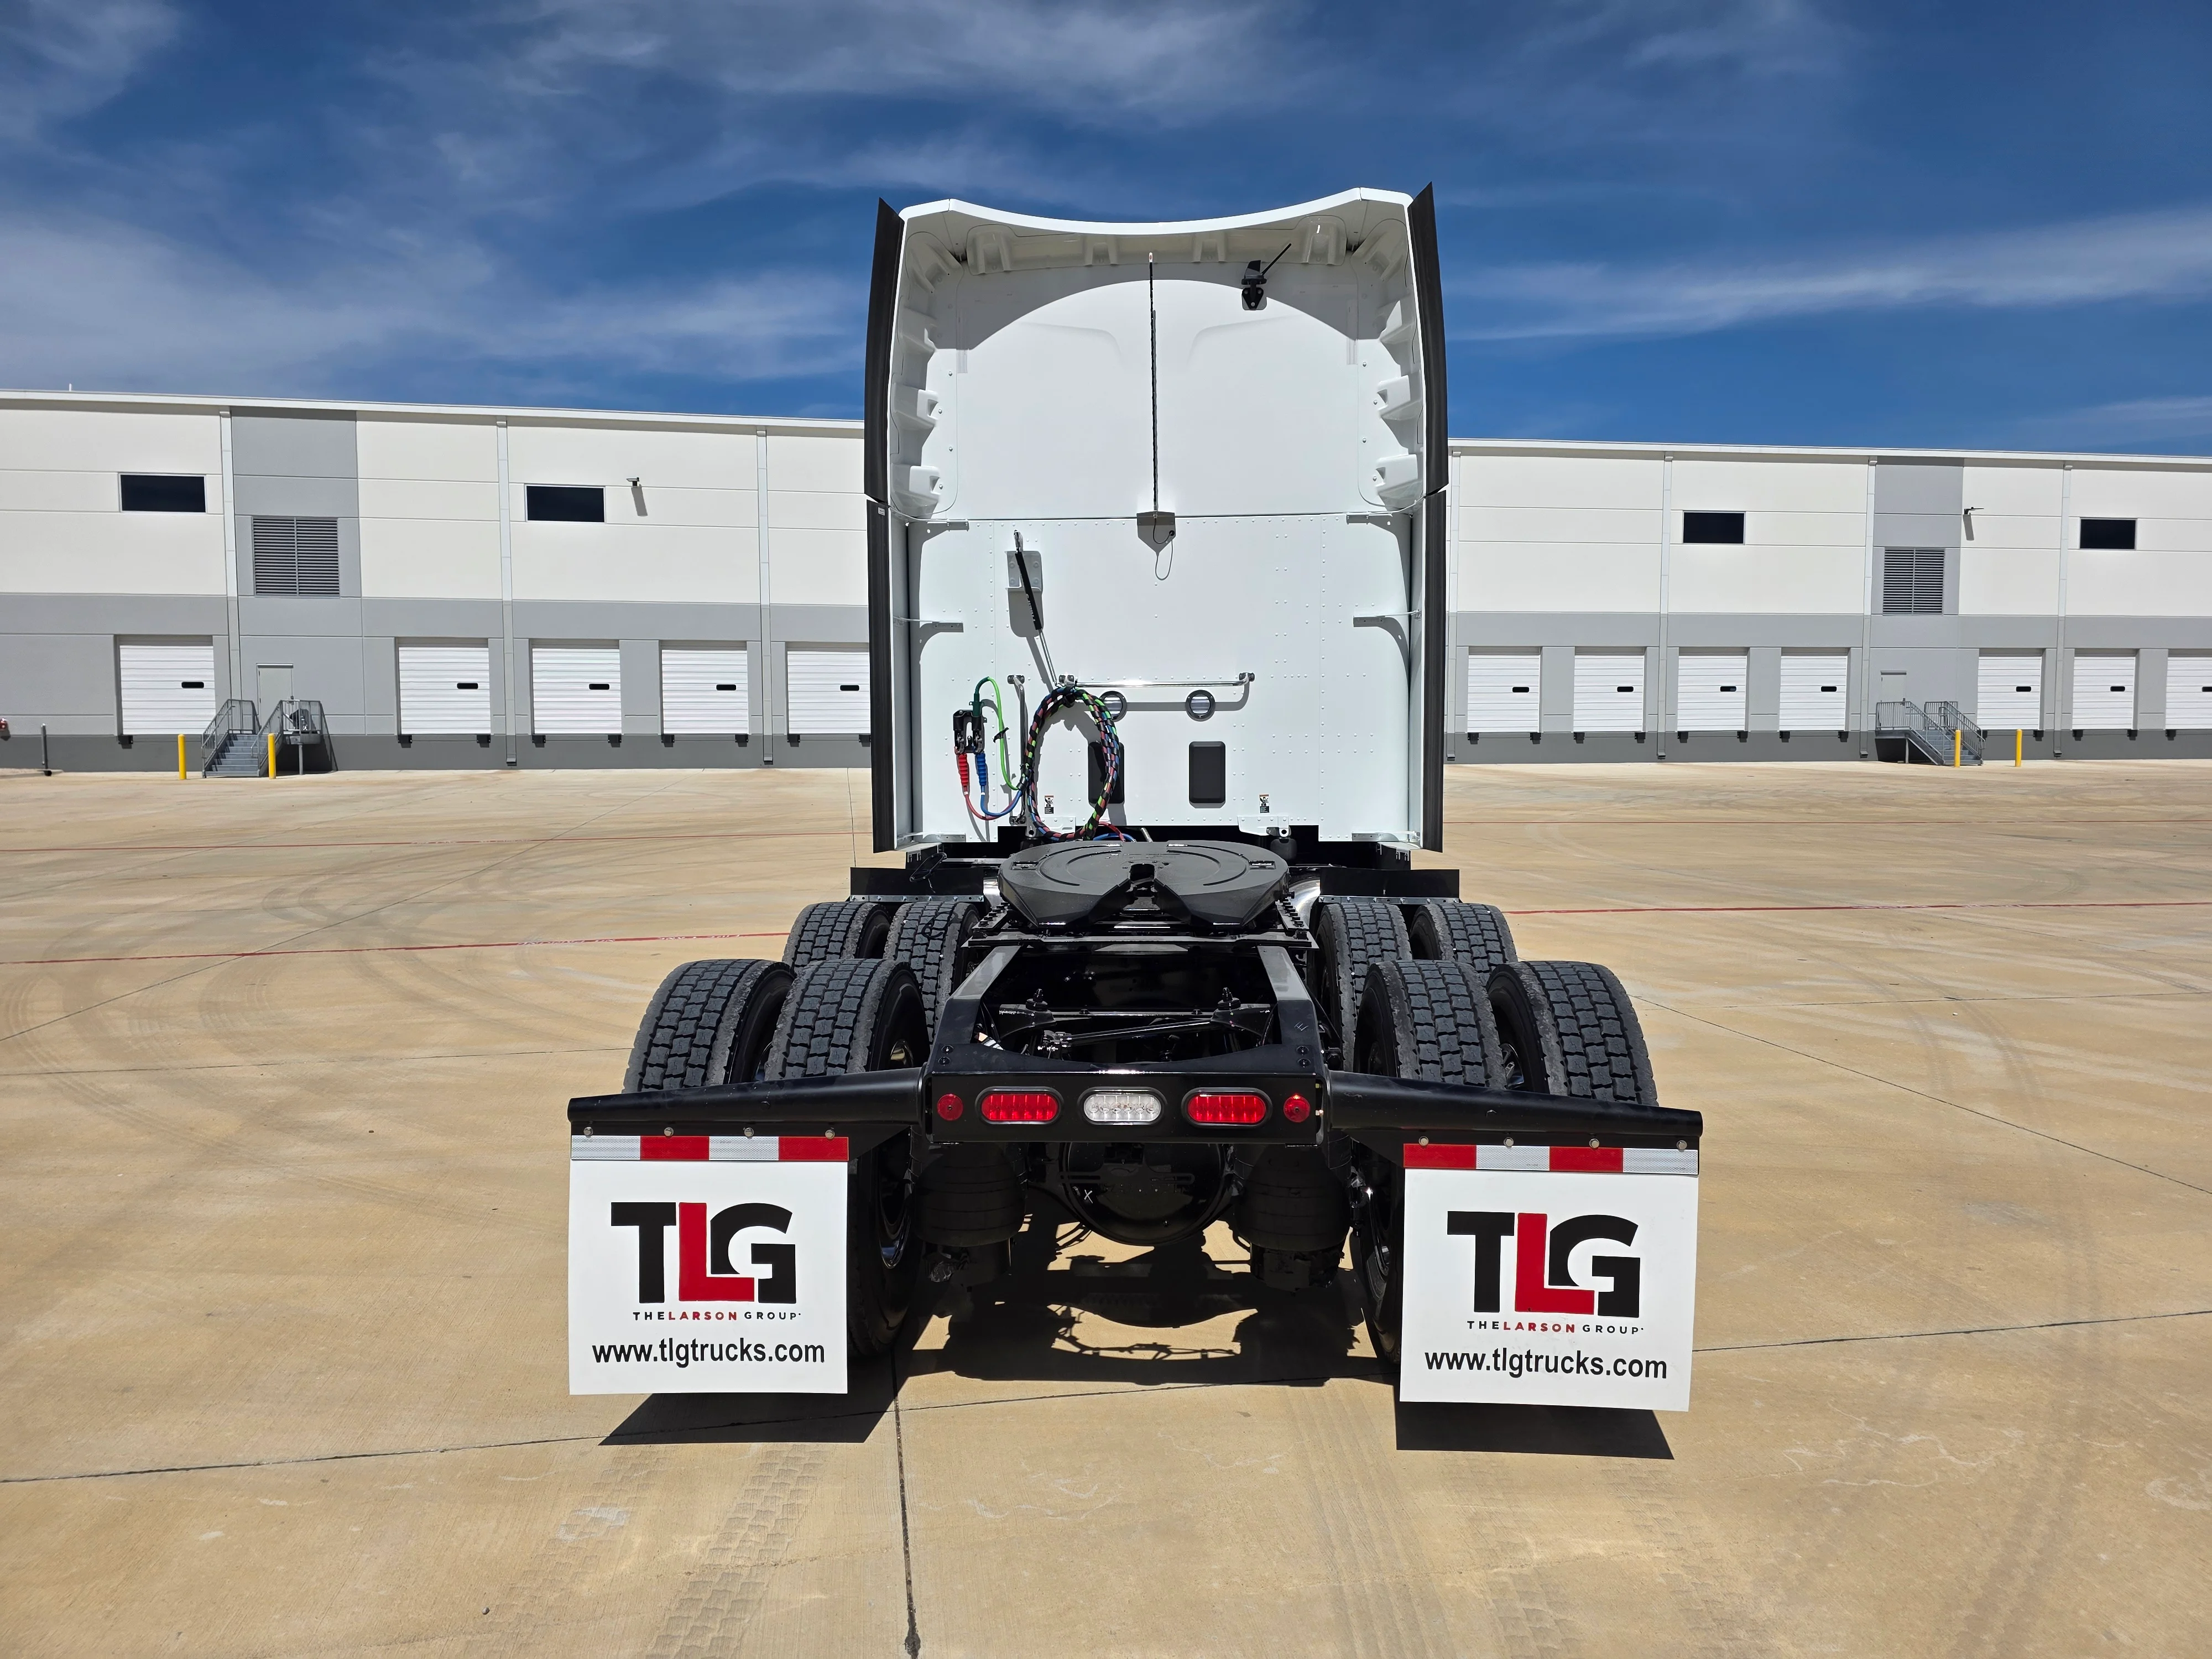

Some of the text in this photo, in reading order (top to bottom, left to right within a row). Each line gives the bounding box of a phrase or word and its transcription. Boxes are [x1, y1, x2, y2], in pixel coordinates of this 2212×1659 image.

[611, 1202, 796, 1303] TLG
[1447, 1211, 1640, 1318] TLG
[744, 1311, 796, 1320] GROUP
[1582, 1324, 1639, 1334] GROUP
[592, 1338, 825, 1368] www.tlgtrucks.com
[1425, 1348, 1667, 1379] www.tlgtrucks.com
